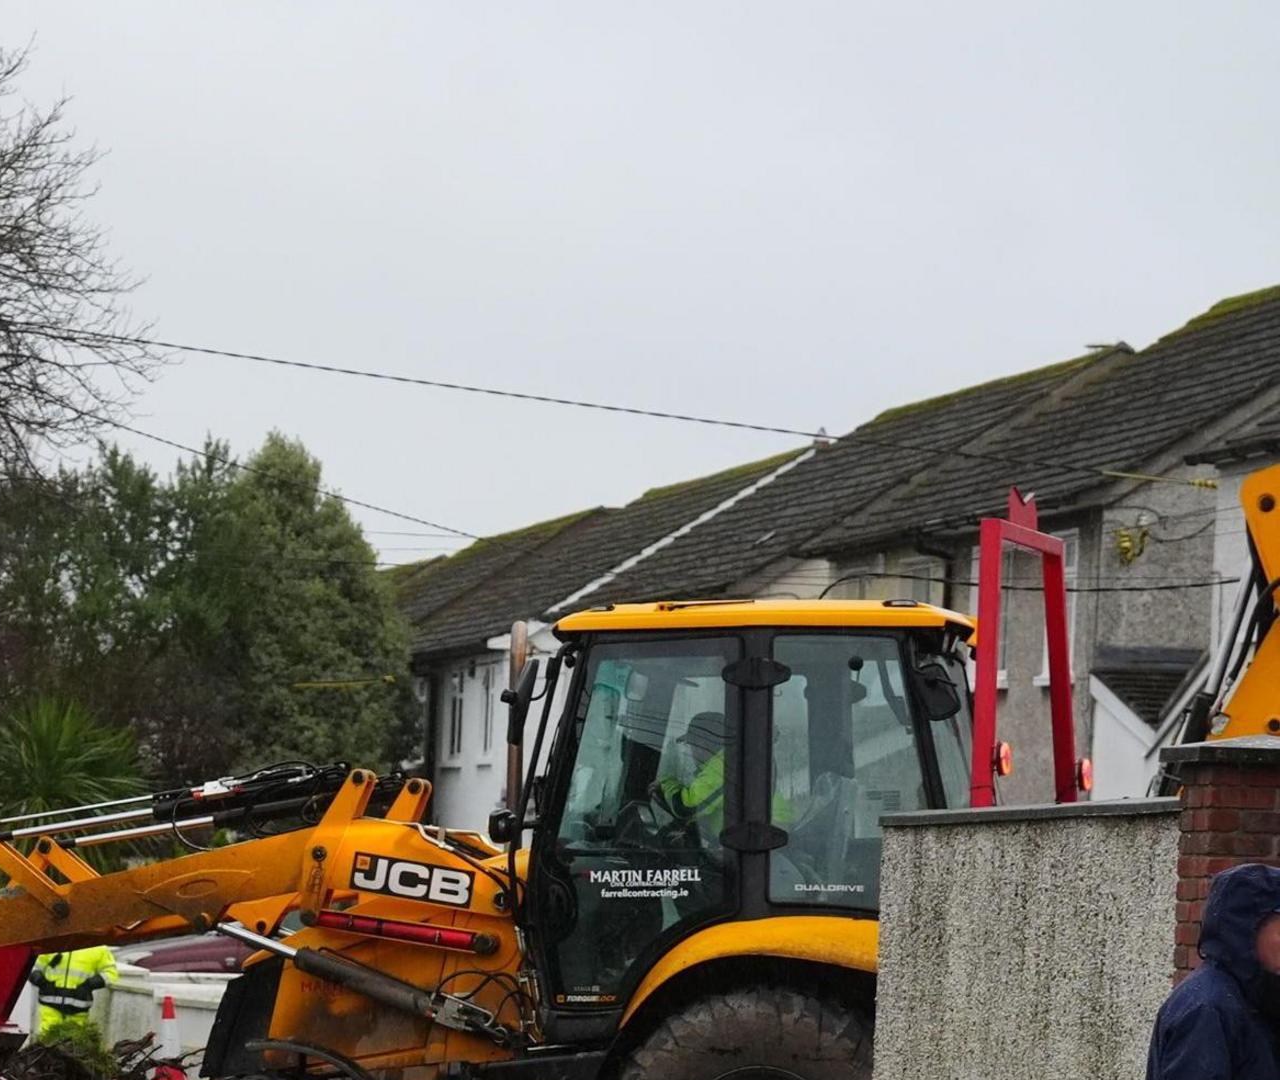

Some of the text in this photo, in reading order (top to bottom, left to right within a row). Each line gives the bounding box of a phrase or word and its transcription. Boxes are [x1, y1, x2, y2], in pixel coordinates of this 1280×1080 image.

[354, 858, 470, 905] JCB
[589, 868, 701, 883] MARTIN FARRELL
[601, 888, 689, 899] farrellcontracting.ie
[794, 883, 864, 892] DUALDRIVE
